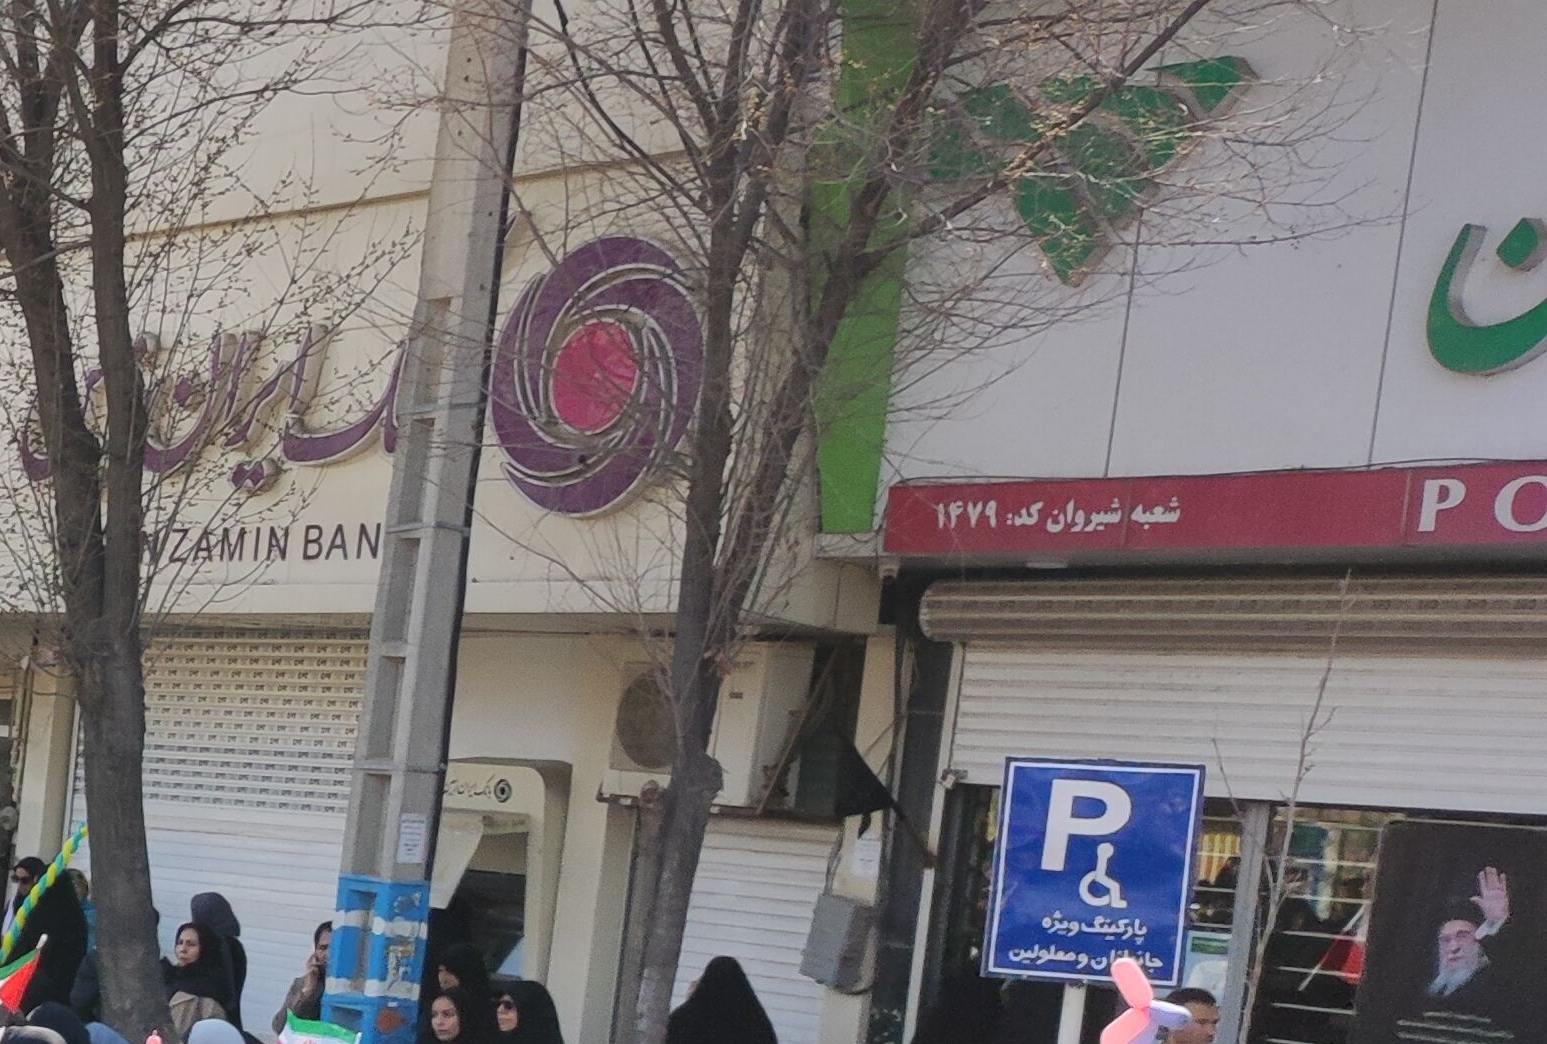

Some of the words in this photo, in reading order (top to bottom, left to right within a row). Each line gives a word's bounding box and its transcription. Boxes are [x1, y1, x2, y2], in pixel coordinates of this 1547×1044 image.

[935, 502, 998, 530] ۱۴۷۹
[1045, 496, 1122, 534] شیروان
[1130, 496, 1181, 525] شعبه
[1040, 778, 1132, 872] P
[1041, 910, 1081, 938] ویژه
[1081, 914, 1148, 944] پارکینگ
[1008, 943, 1077, 966] معلولین
